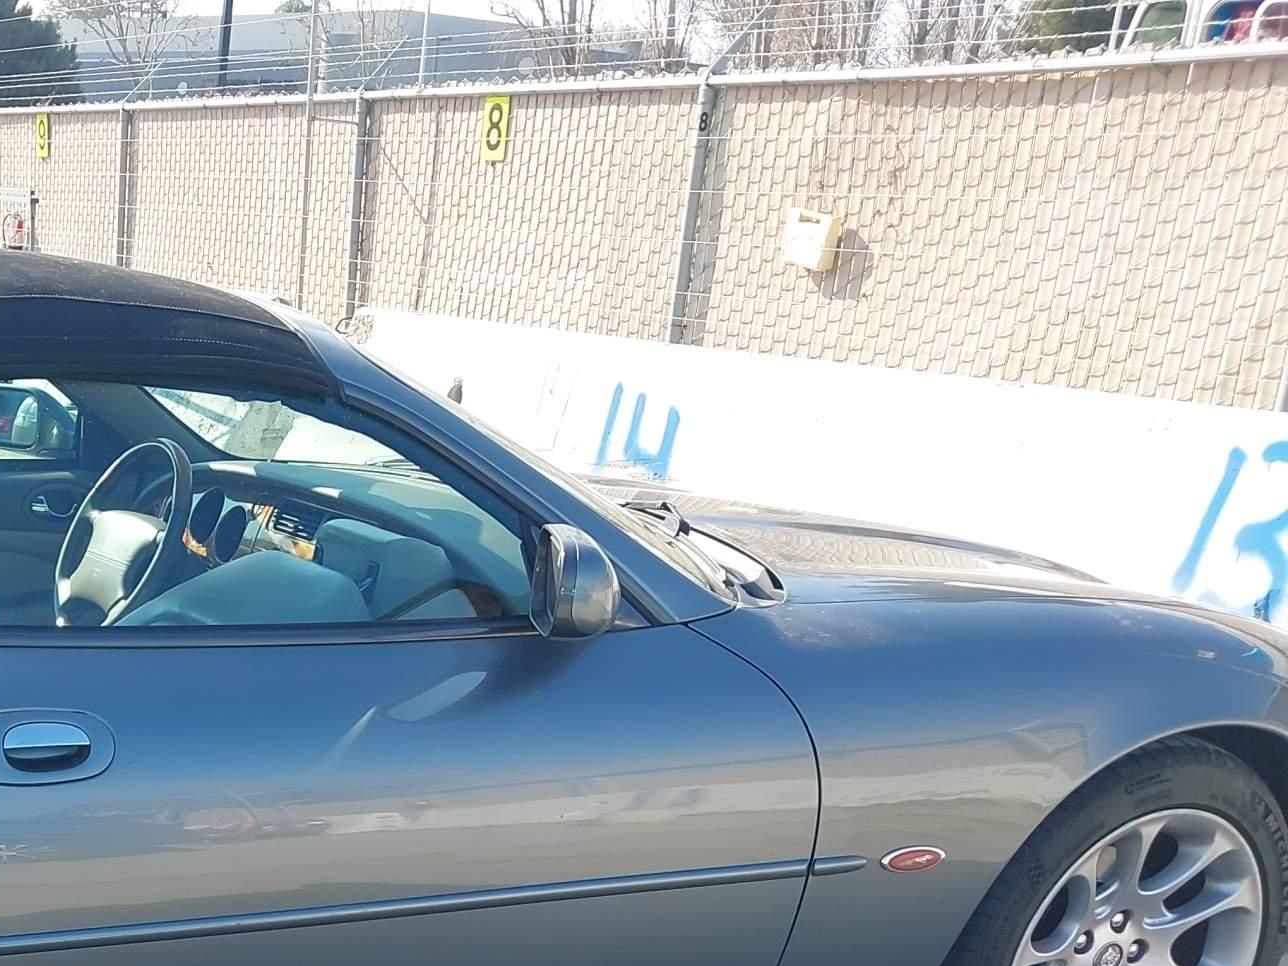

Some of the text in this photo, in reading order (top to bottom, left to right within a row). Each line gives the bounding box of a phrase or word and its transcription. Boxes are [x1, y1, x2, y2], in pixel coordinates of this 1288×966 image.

[38, 119, 46, 150] 9
[486, 103, 503, 151] 8
[699, 112, 709, 132] 8
